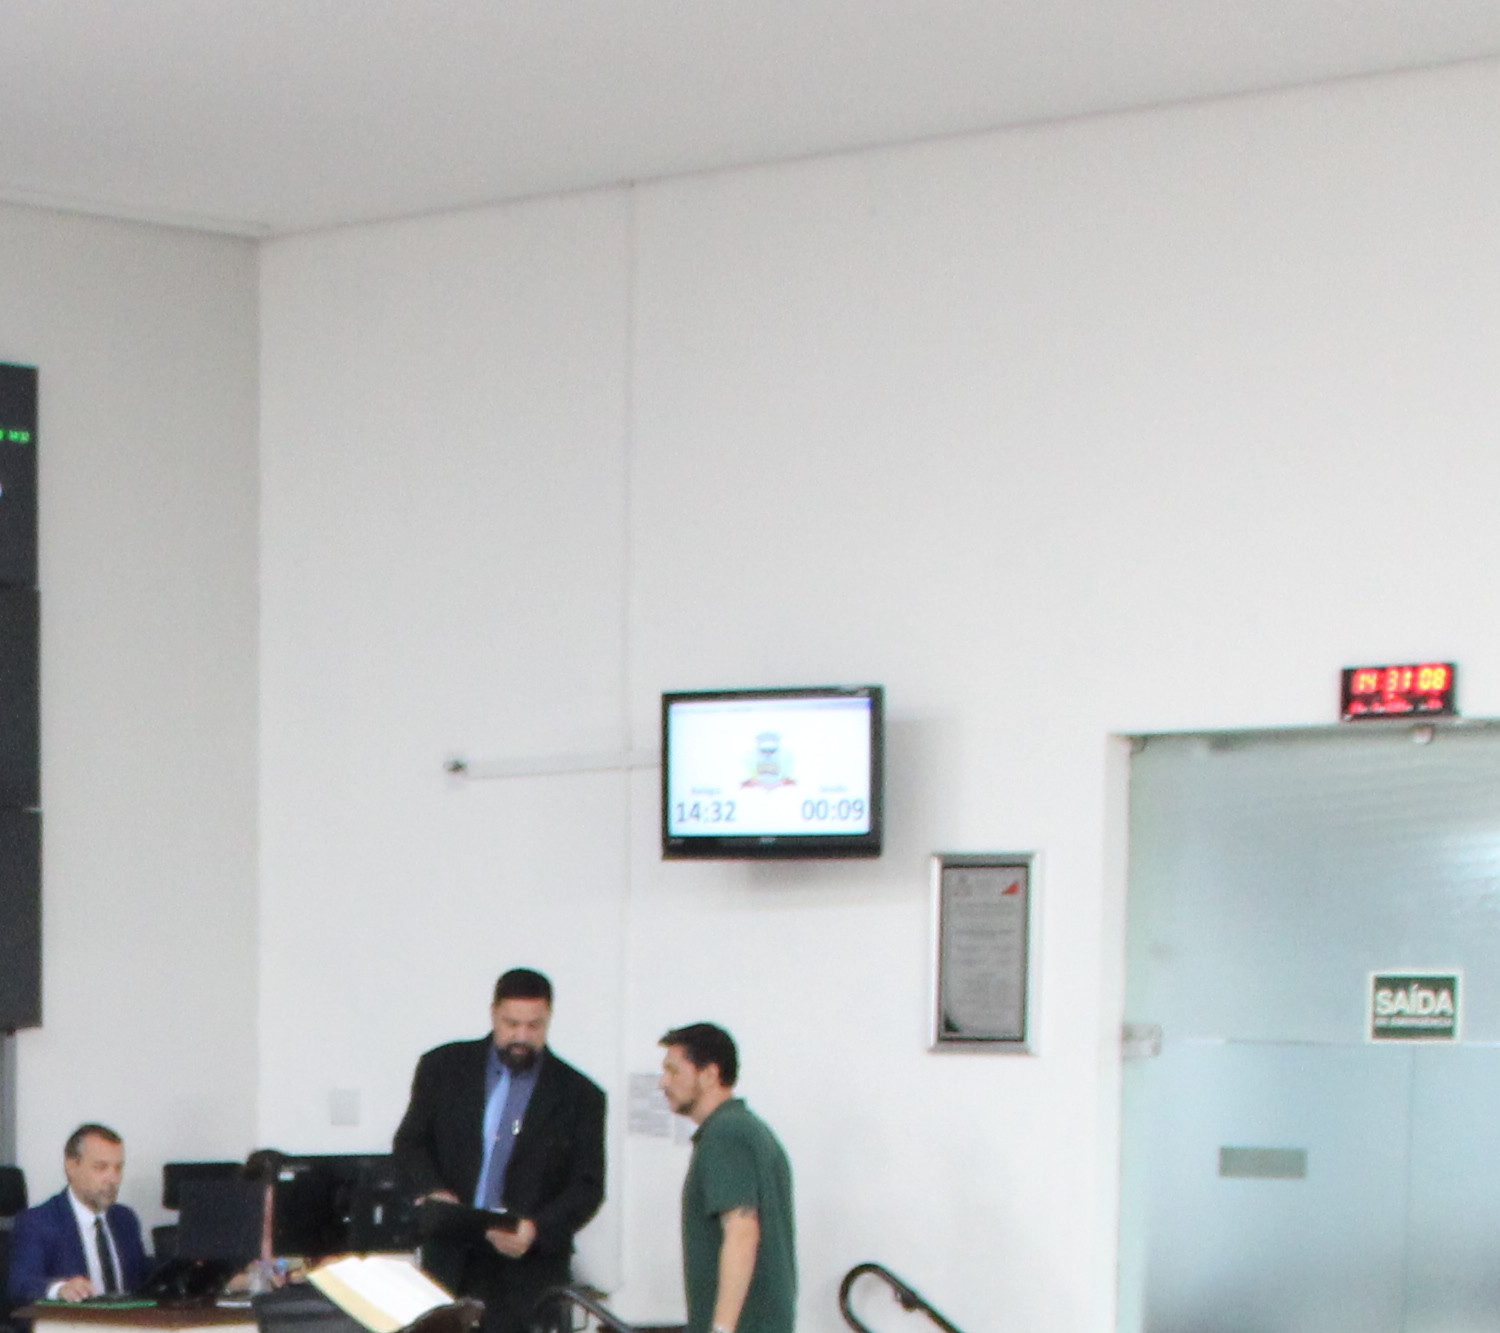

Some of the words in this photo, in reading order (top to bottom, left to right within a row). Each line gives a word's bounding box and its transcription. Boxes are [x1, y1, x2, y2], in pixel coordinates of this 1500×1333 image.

[676, 800, 736, 823] 14:32
[802, 799, 864, 822] 00:09
[1375, 983, 1453, 1016] SAÍDA
